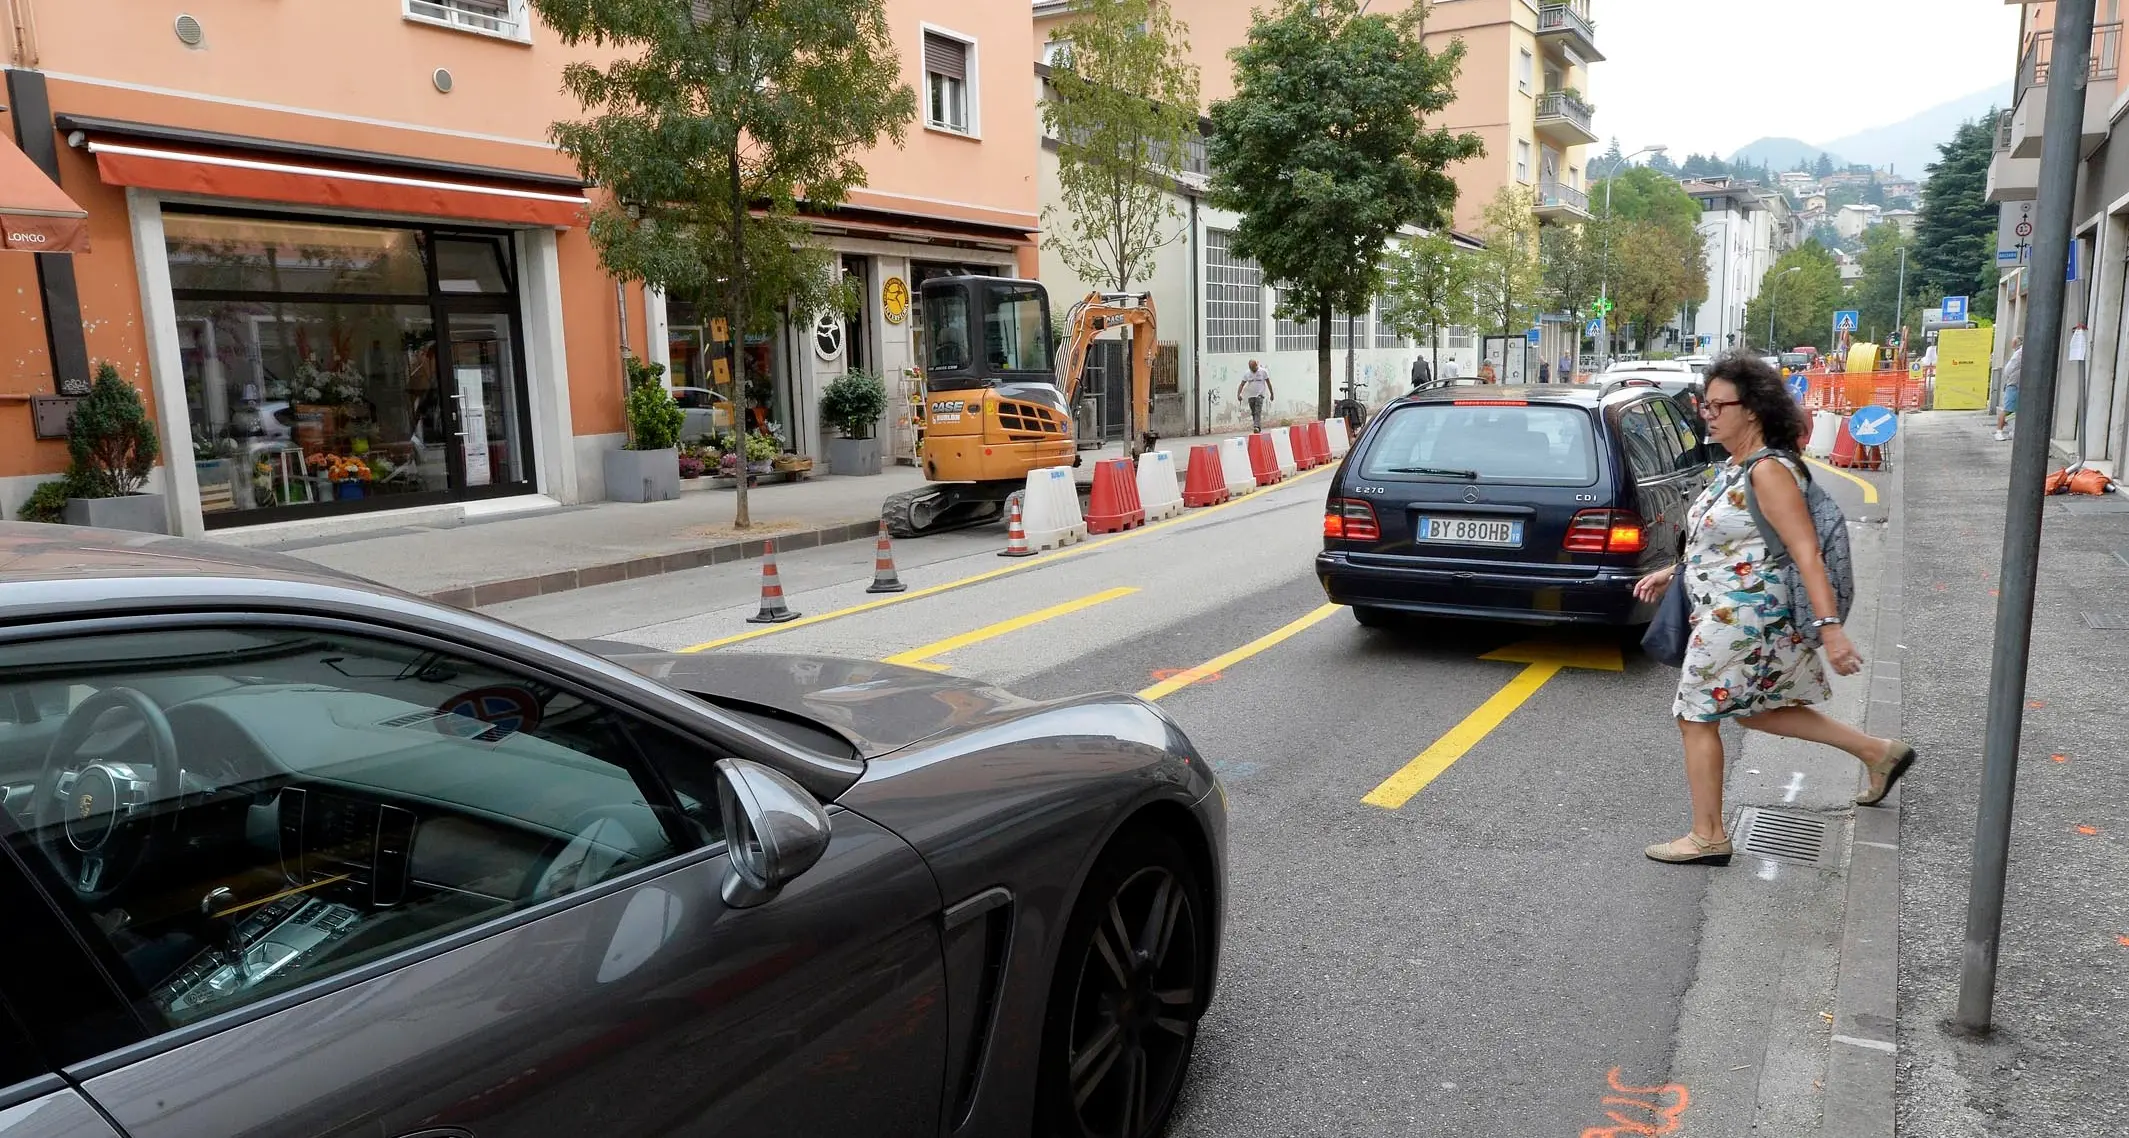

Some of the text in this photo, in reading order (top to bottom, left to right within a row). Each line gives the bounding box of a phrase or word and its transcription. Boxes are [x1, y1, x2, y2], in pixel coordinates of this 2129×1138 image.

[7, 231, 46, 243] LONGO
[931, 401, 965, 413] CASE
[1430, 520, 1451, 538] BY
[1456, 522, 1510, 541] 880HB
